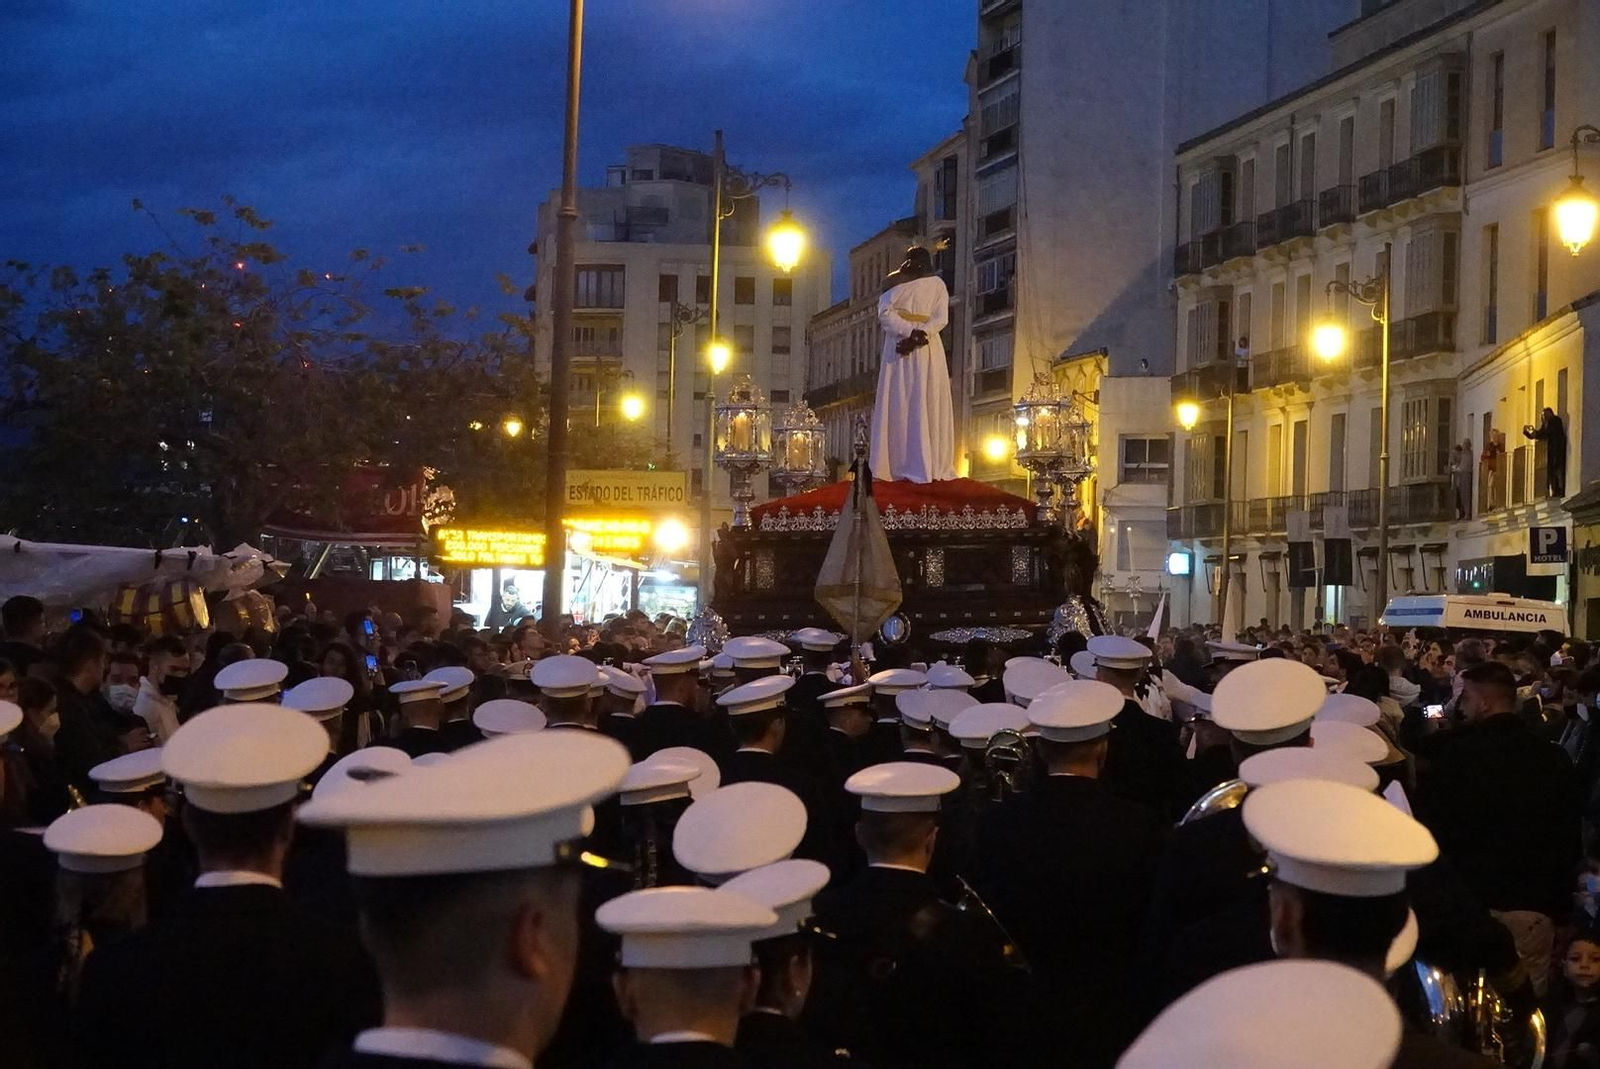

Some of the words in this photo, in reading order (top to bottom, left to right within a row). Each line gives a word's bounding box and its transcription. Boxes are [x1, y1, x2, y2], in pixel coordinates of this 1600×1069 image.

[569, 484, 611, 501] ESTADO
[613, 485, 634, 501] DEL
[637, 483, 683, 502] TRÁFICO
[1539, 528, 1558, 554] P
[1534, 554, 1563, 562] HOTEL
[1463, 608, 1547, 623] AMBULANCIA
